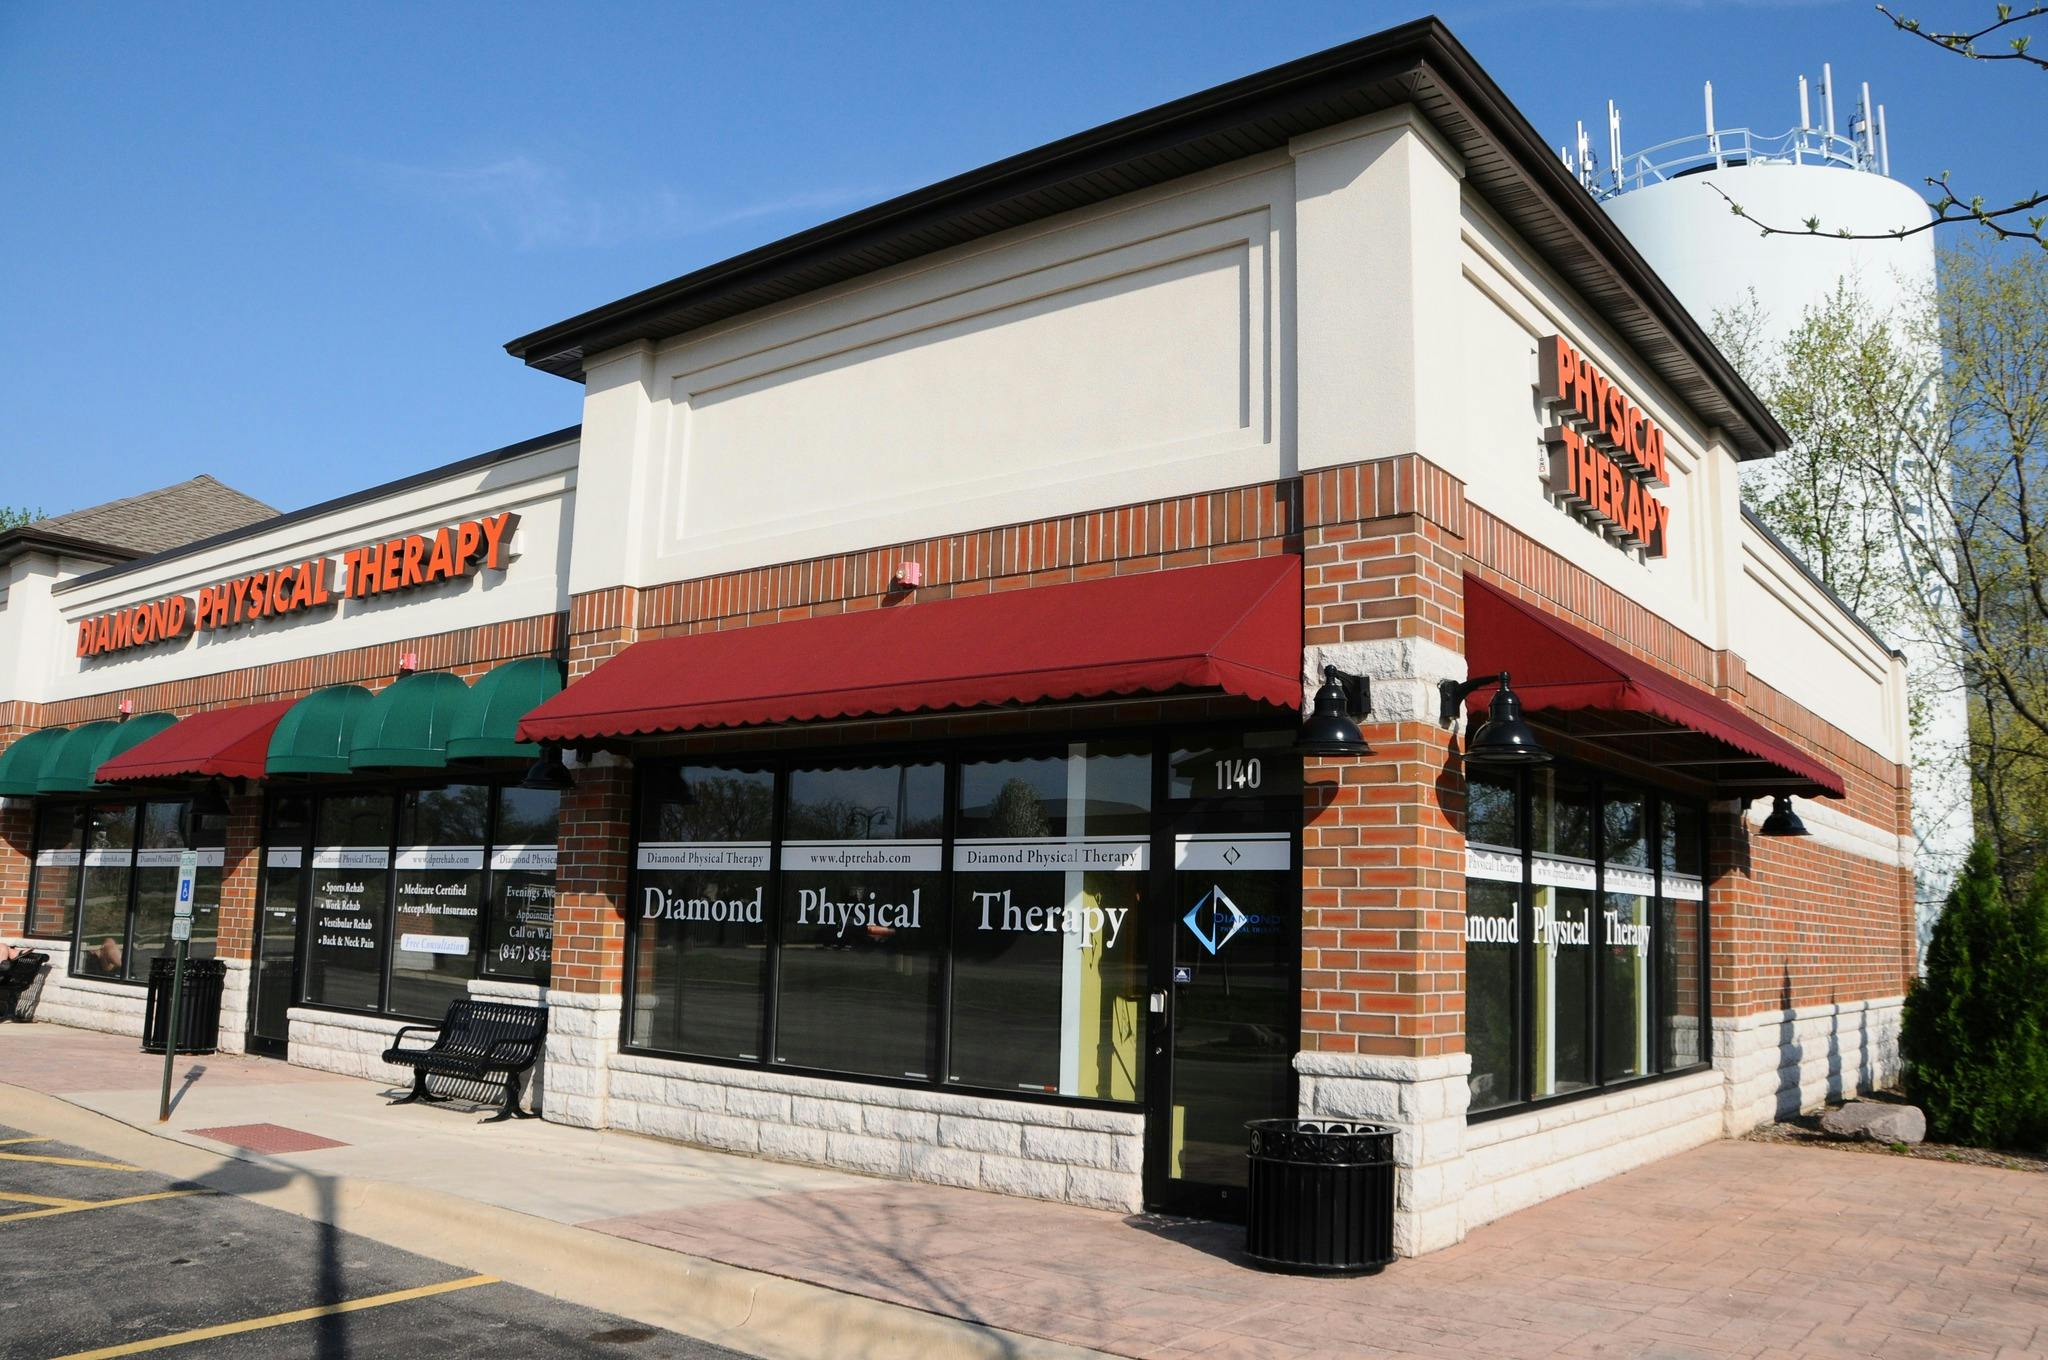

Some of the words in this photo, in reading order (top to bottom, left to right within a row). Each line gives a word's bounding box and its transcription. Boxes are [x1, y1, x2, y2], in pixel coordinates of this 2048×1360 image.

[1556, 334, 1670, 486] PHYSICAL
[1562, 425, 1669, 559] THERAPY
[76, 596, 189, 657] DIAMOND
[195, 557, 332, 631] PHYSICAL
[344, 512, 515, 599] THERAPY
[1216, 758, 1261, 790] 1140
[342, 854, 363, 866] Physical
[365, 854, 386, 867] Therapy
[500, 853, 529, 864] Diamond
[531, 853, 557, 867] Physica
[647, 852, 686, 864] Diamond
[688, 852, 723, 867] Physical
[726, 852, 764, 867] Therapy
[810, 851, 911, 867] www.dptrehab.com
[967, 850, 1023, 864] Diamond
[1027, 850, 1078, 867] Physical
[1084, 849, 1137, 866] Therapy
[326, 882, 345, 895] Sports
[346, 882, 364, 892] Rehab
[404, 883, 434, 894] Medicare
[435, 884, 467, 896] Certified
[506, 885, 540, 901] Evenings
[325, 899, 341, 909] Work
[342, 900, 360, 910] Rehab
[402, 902, 424, 917] Accept
[425, 903, 442, 914] Most
[443, 904, 478, 916] Insurances
[324, 917, 353, 928] Vestibular
[353, 918, 372, 929] Rehab
[516, 909, 555, 922] Appointme
[642, 886, 763, 924] Diamond
[797, 887, 921, 938] Physical
[972, 889, 1129, 948] Therapy
[1213, 912, 1280, 924] DIAMOND
[509, 925, 525, 938] Call
[527, 930, 535, 938] or
[537, 926, 552, 939] Wal
[1533, 905, 1590, 959] Physical
[1604, 909, 1651, 957] Therapy
[322, 934, 336, 945] Back
[344, 936, 359, 947] Neck
[360, 937, 374, 948] Pain
[499, 943, 526, 963] (847)
[528, 944, 550, 962] 854-
